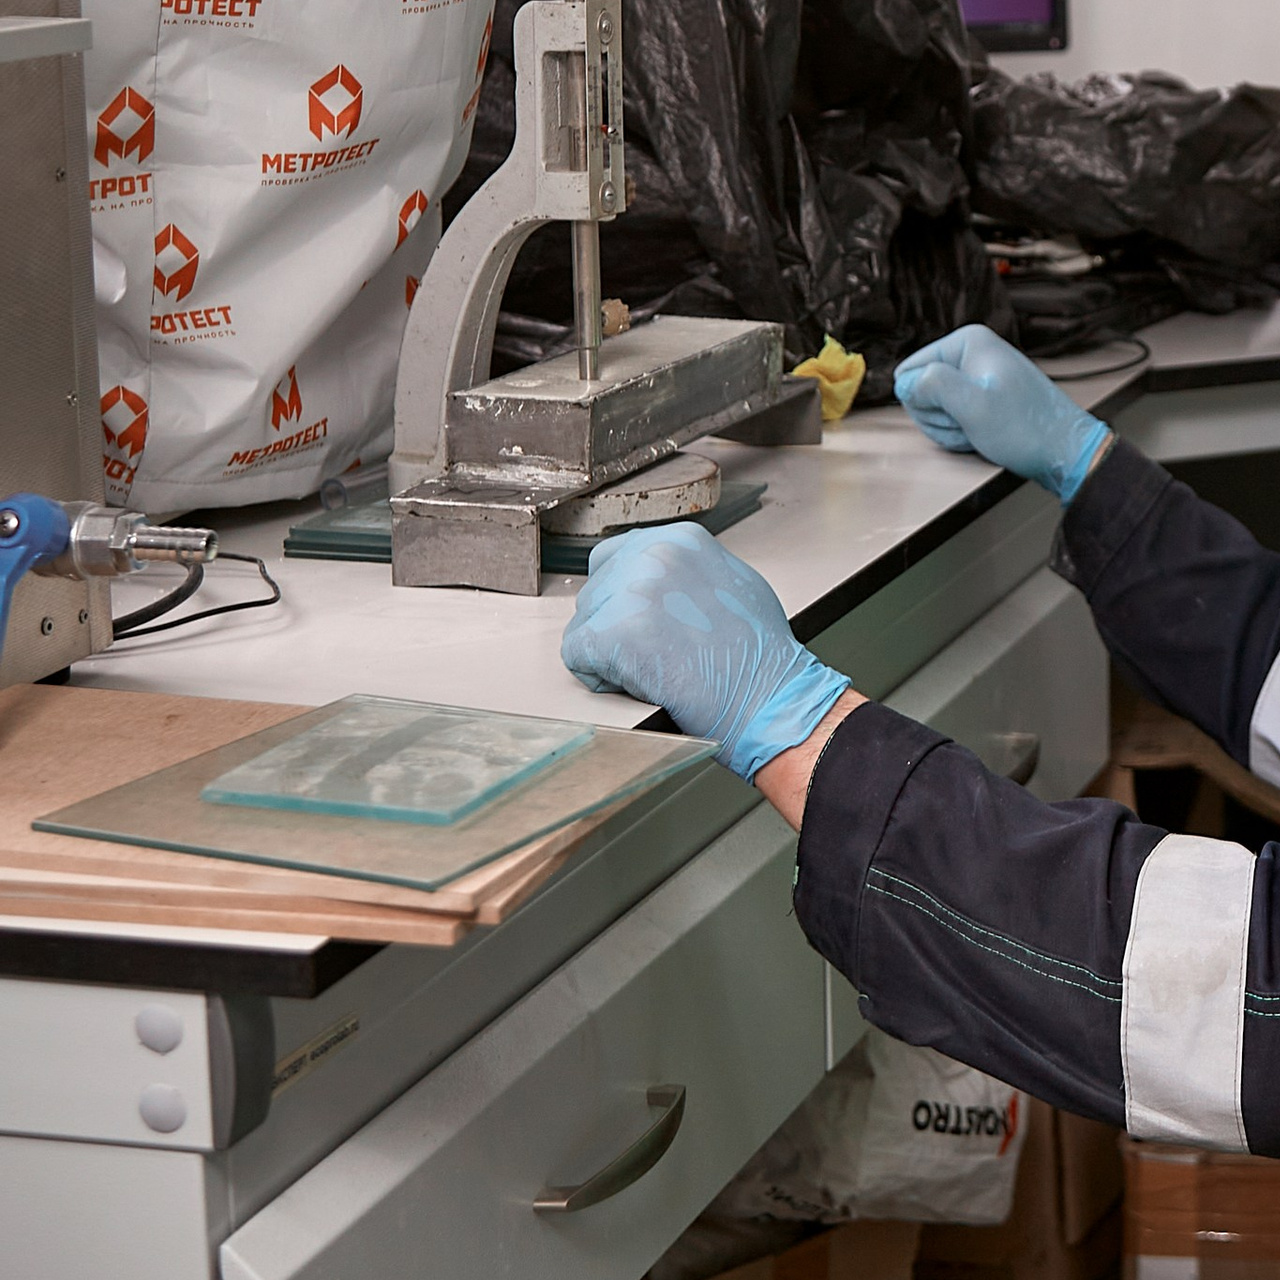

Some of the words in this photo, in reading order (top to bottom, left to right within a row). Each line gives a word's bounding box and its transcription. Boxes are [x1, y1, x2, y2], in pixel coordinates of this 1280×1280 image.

[402, 3, 441, 15] ПРОВЕРКА
[183, 19, 255, 29] ПРОЧНОСТЬ
[261, 138, 380, 174] МЕТРОТЕСТ
[261, 176, 310, 186] ПРОВЕРКА
[111, 202, 125, 210] НА
[131, 197, 153, 207] ПРО
[174, 329, 236, 345] ПРОЧНОСТЬ
[226, 416, 329, 467] МЕТРОТЕСТ
